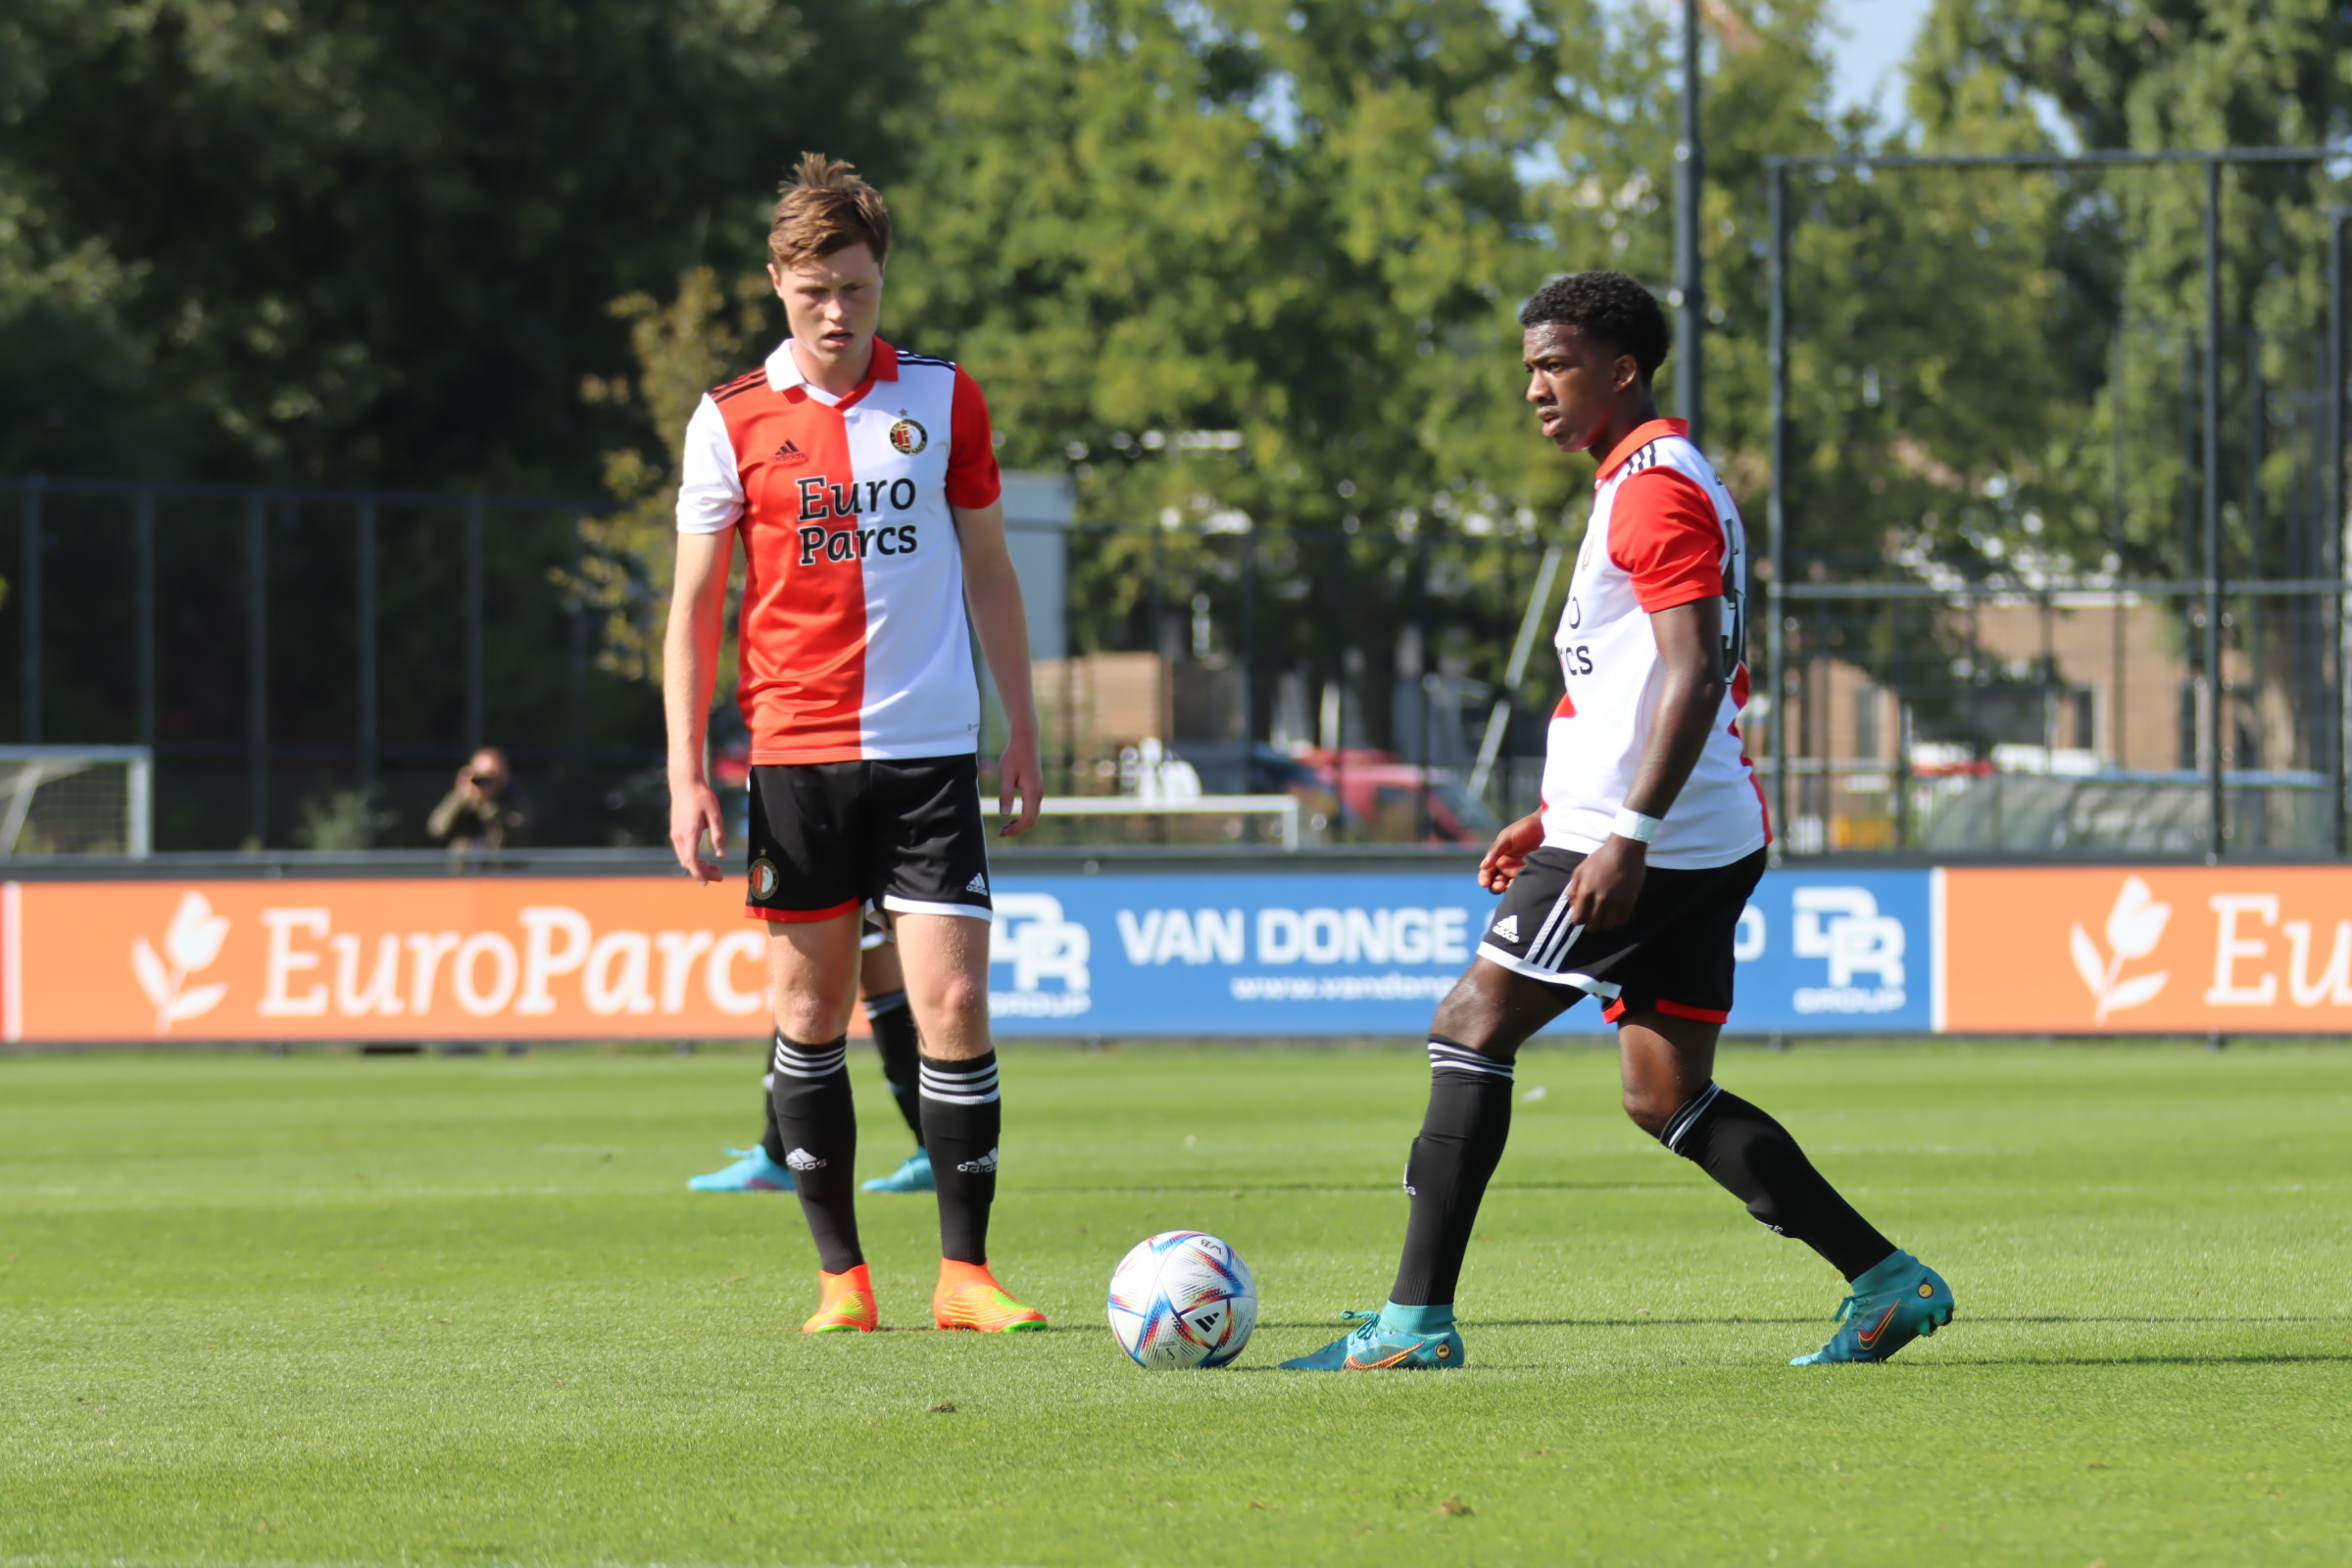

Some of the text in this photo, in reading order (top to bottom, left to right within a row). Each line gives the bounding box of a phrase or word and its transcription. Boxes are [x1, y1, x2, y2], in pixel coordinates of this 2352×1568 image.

[796, 475, 916, 521] Euro
[799, 525, 917, 565] Parcs
[1117, 907, 1245, 965] VAN
[1256, 906, 1469, 964] DONGE
[1230, 971, 1461, 1003] www.vandong
